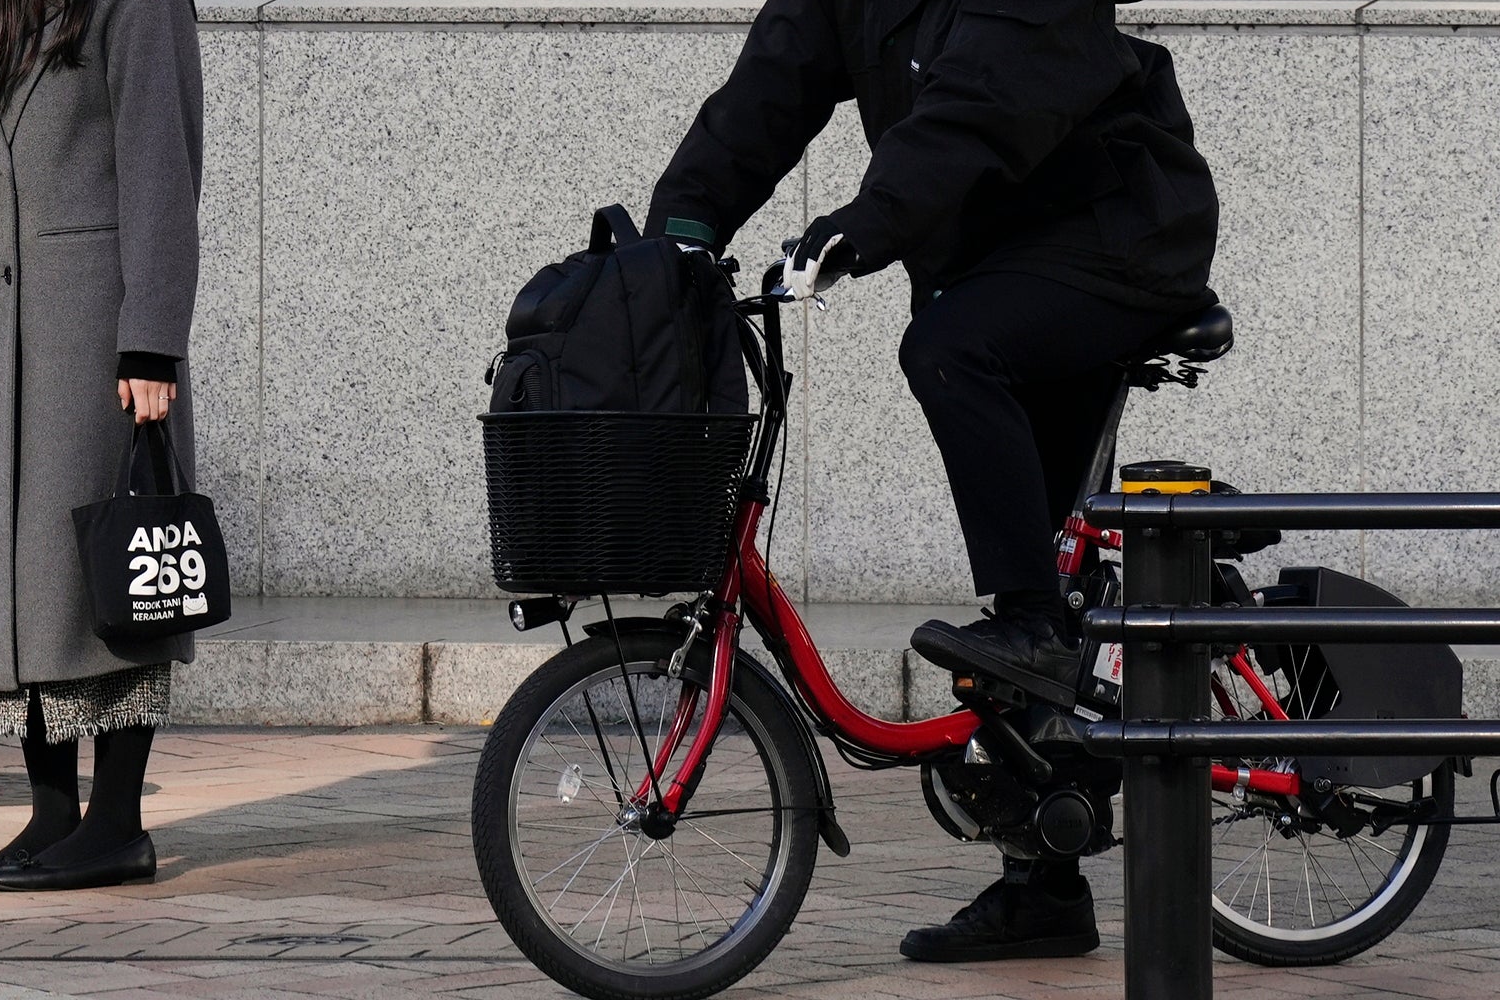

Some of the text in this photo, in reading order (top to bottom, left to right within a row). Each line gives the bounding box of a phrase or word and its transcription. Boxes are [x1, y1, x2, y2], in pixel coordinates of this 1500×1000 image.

[128, 549, 206, 595] 269
[162, 598, 181, 608] TANI
[133, 610, 174, 622] KERAJAAN
